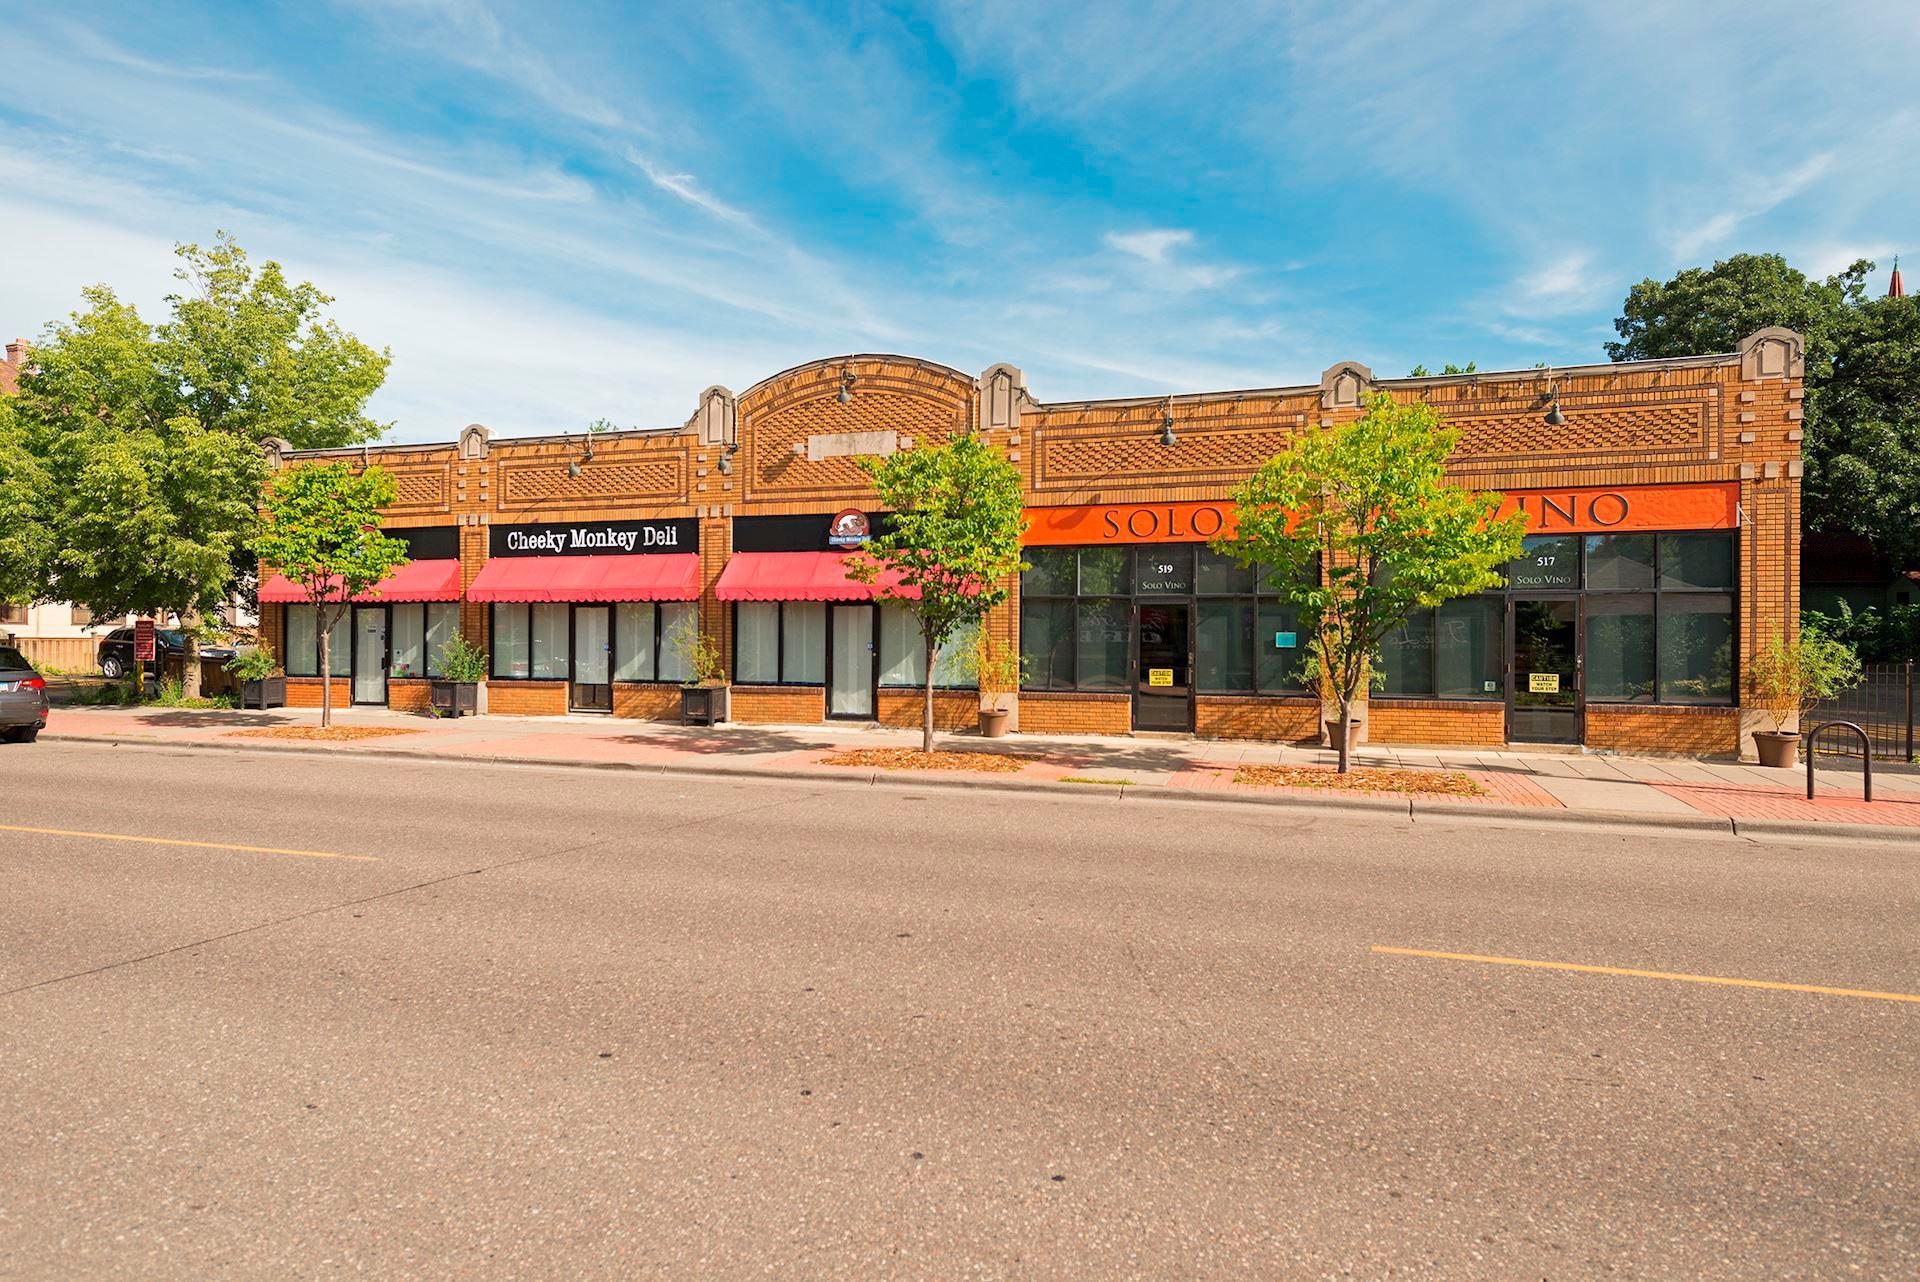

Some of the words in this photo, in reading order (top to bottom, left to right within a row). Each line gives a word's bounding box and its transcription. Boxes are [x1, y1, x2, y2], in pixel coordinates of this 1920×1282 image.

[1103, 507, 1223, 538] SOLO
[507, 530, 567, 553] Cheeky
[570, 528, 638, 551] Monkey
[643, 526, 678, 546] Deli
[1536, 556, 1556, 567] 517
[1157, 564, 1174, 574] 519
[1531, 674, 1558, 682] CAUTION
